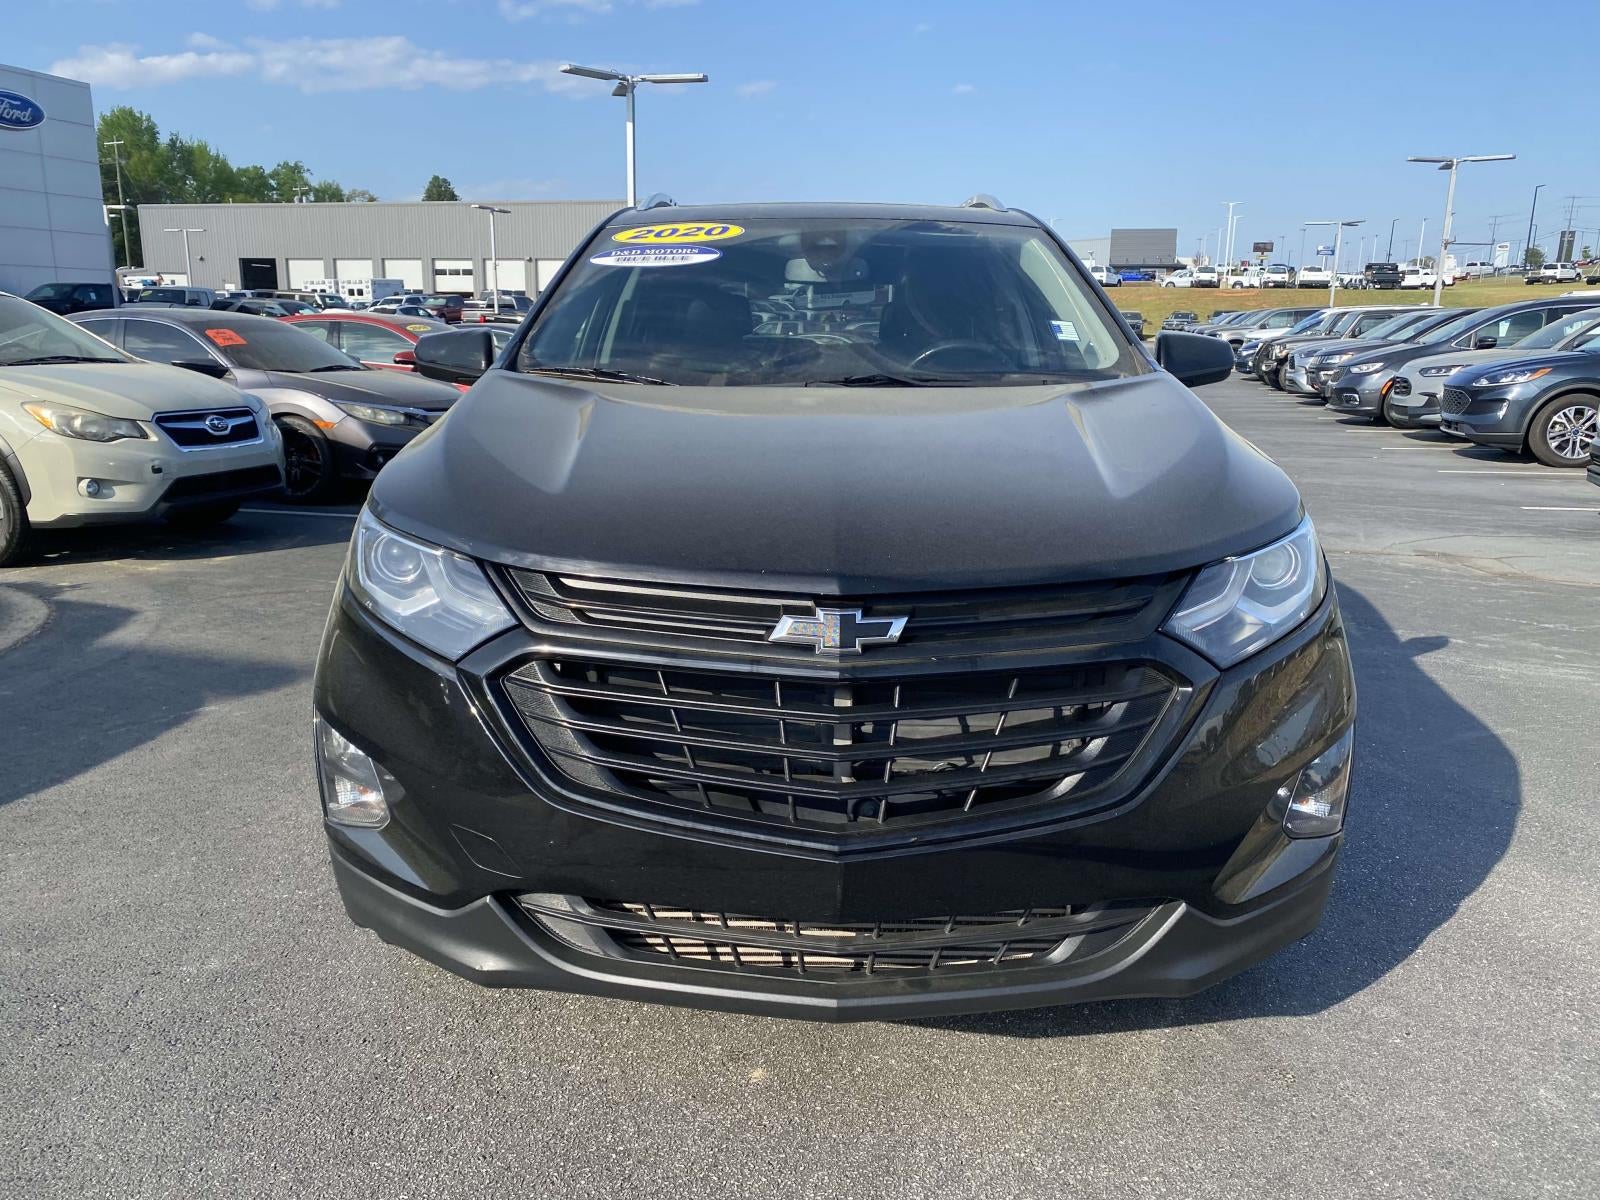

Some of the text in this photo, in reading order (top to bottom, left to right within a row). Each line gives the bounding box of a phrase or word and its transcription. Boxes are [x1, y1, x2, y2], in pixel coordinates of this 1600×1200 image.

[0, 97, 32, 122] Ford
[626, 225, 730, 240] 2020
[610, 249, 641, 257] D&D
